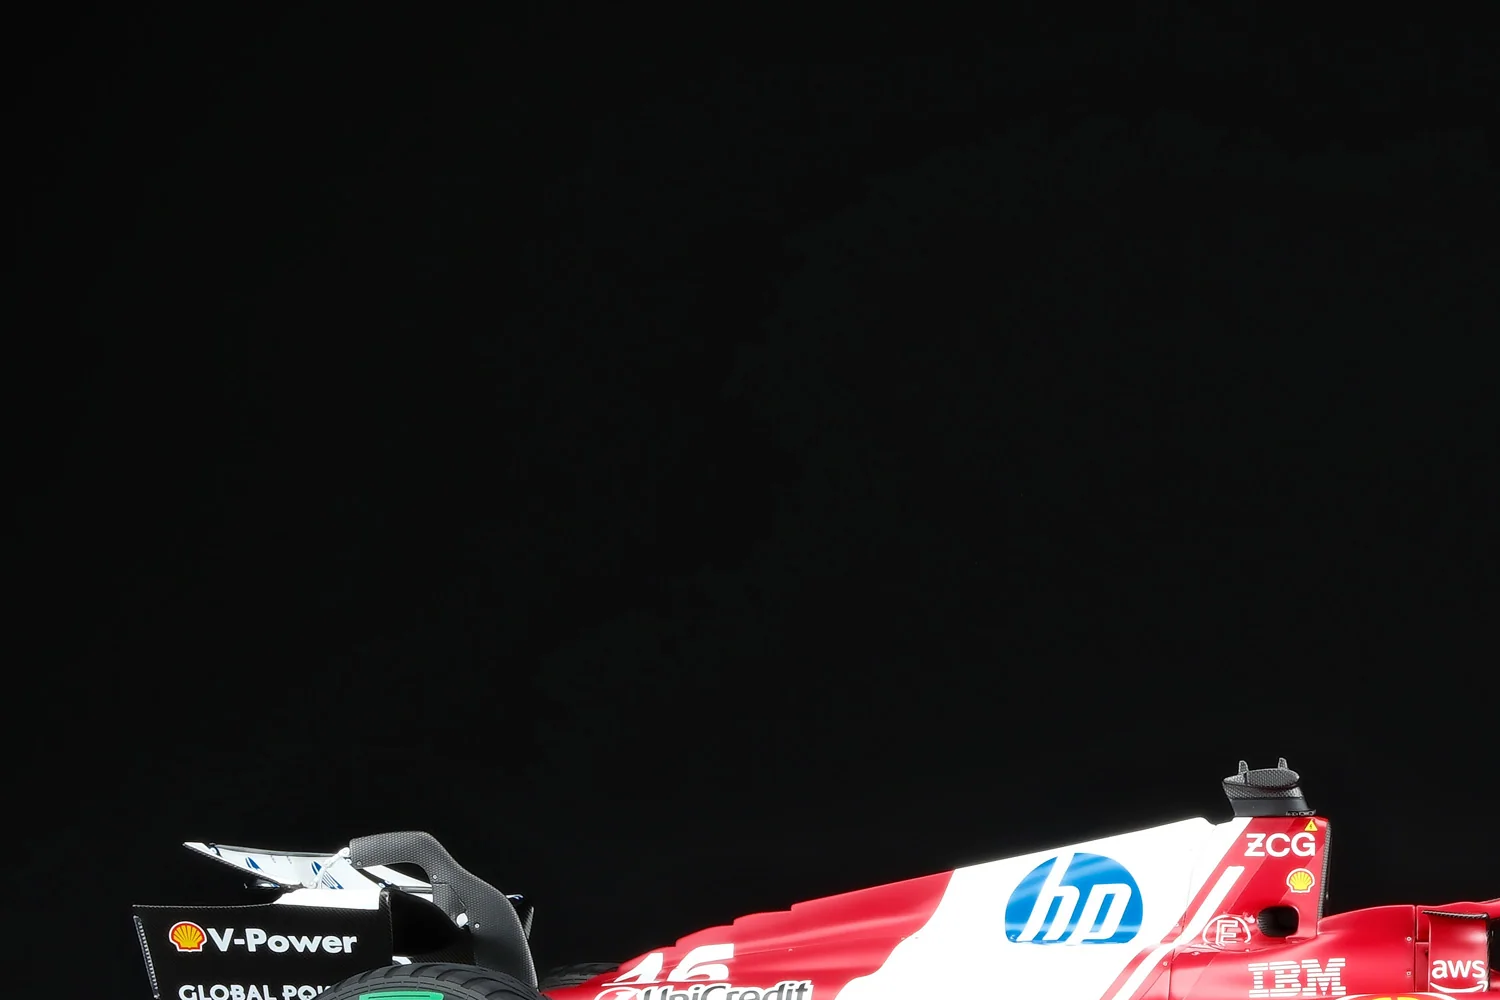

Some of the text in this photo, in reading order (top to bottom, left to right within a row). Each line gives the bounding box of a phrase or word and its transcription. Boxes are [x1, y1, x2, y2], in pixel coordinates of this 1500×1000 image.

[1244, 833, 1316, 857] ZCG
[1013, 853, 1133, 945] hp
[206, 928, 358, 953] V-Power
[1248, 957, 1347, 998] IBM
[1431, 959, 1486, 980] aws
